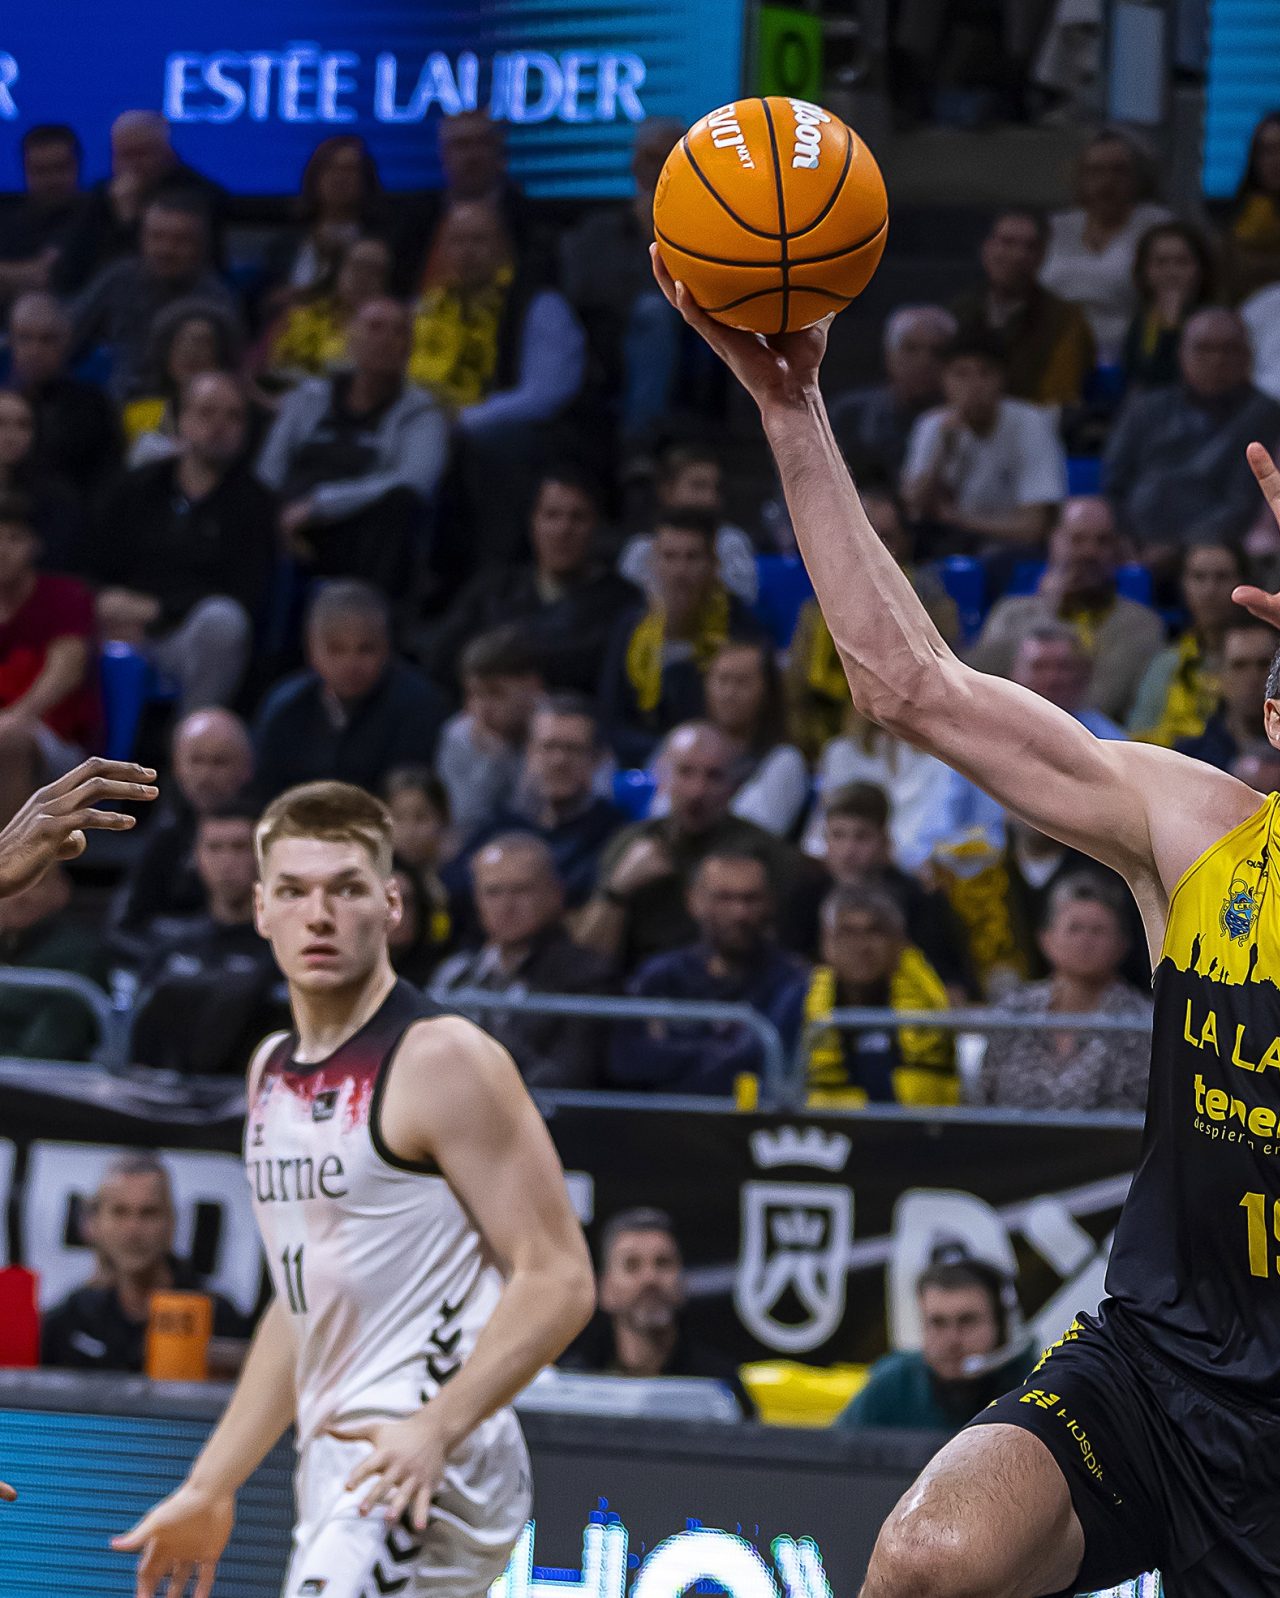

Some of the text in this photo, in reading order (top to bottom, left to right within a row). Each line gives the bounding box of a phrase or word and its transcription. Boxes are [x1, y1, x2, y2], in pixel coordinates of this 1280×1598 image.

[1184, 998, 1220, 1058] LA
[1193, 1116, 1254, 1150] despier
[281, 1242, 309, 1314] 11
